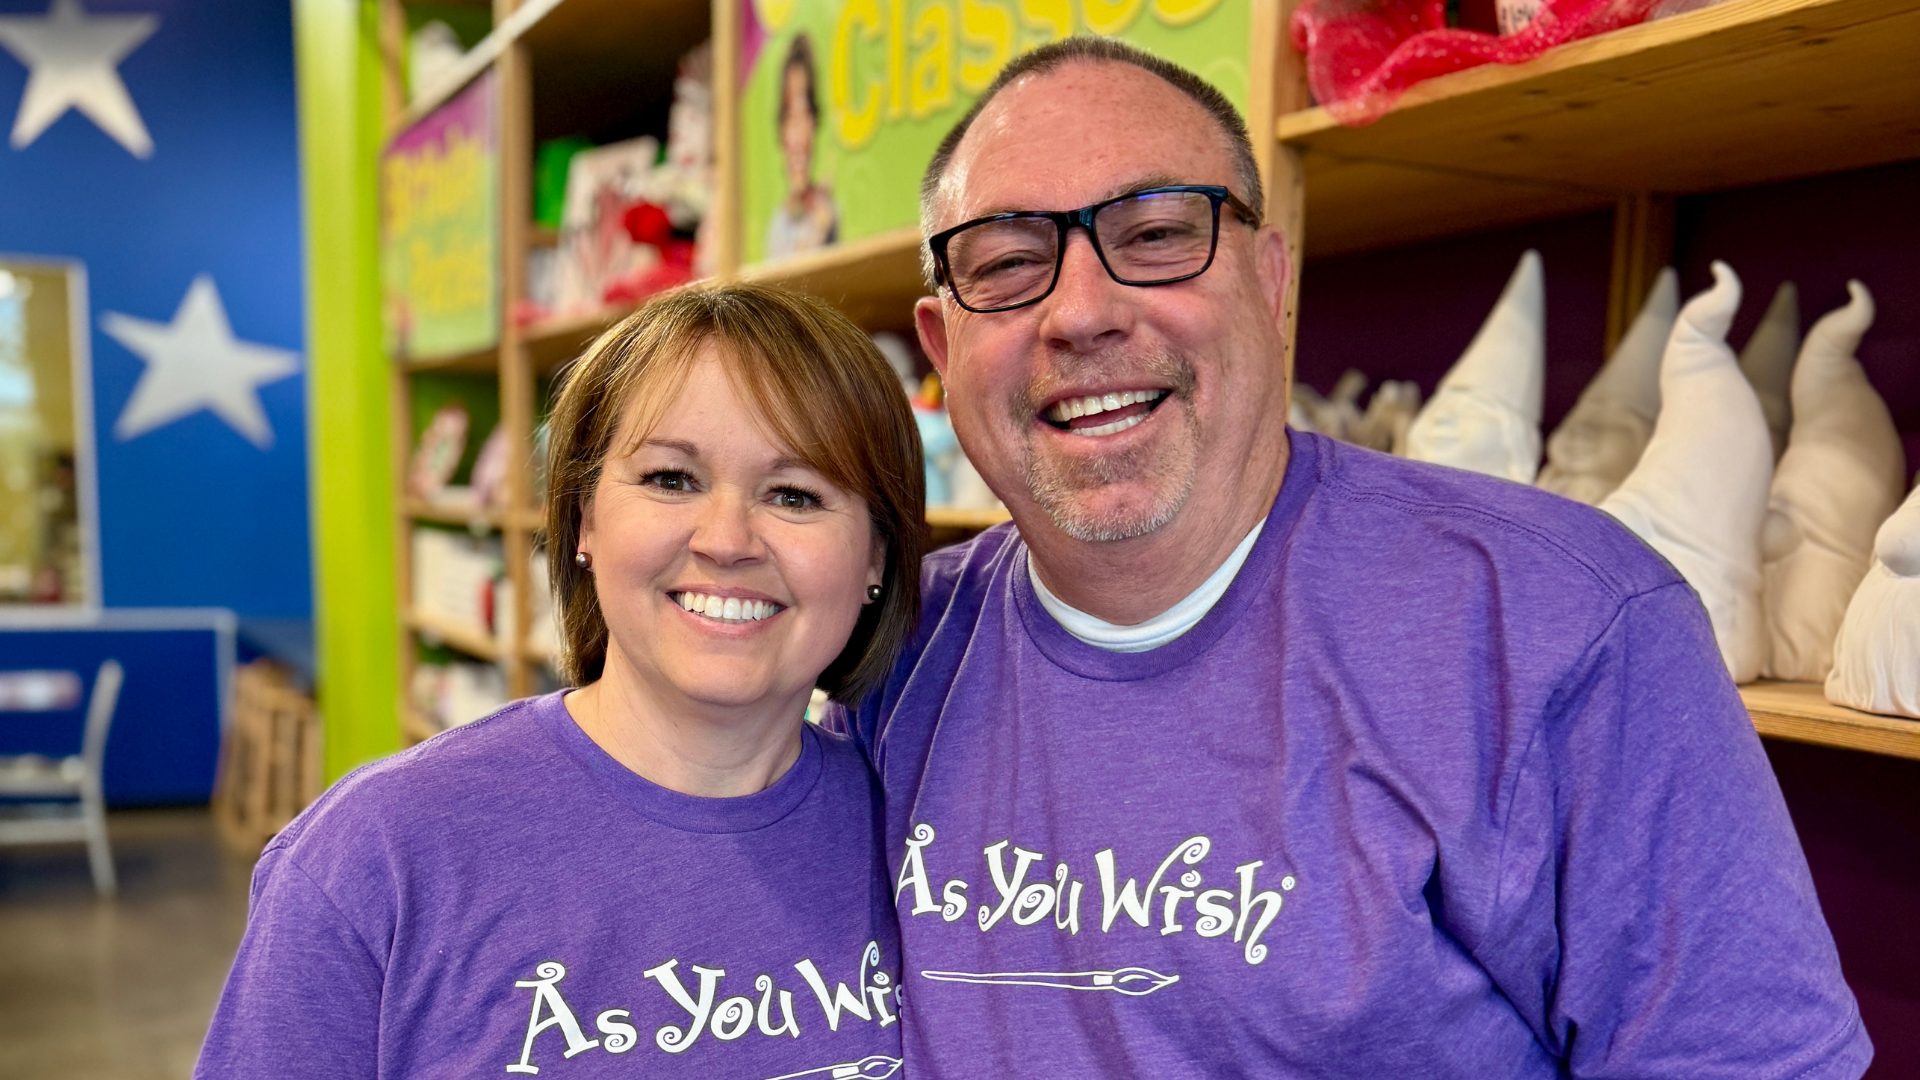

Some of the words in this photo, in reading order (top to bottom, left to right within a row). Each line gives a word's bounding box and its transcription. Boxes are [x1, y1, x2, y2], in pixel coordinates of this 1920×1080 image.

[831, 0, 1224, 148] Clas
[895, 823, 969, 922] As
[978, 840, 1083, 935] You
[506, 961, 638, 1074] As
[643, 958, 801, 1053] You
[794, 940, 902, 1032] Wi
